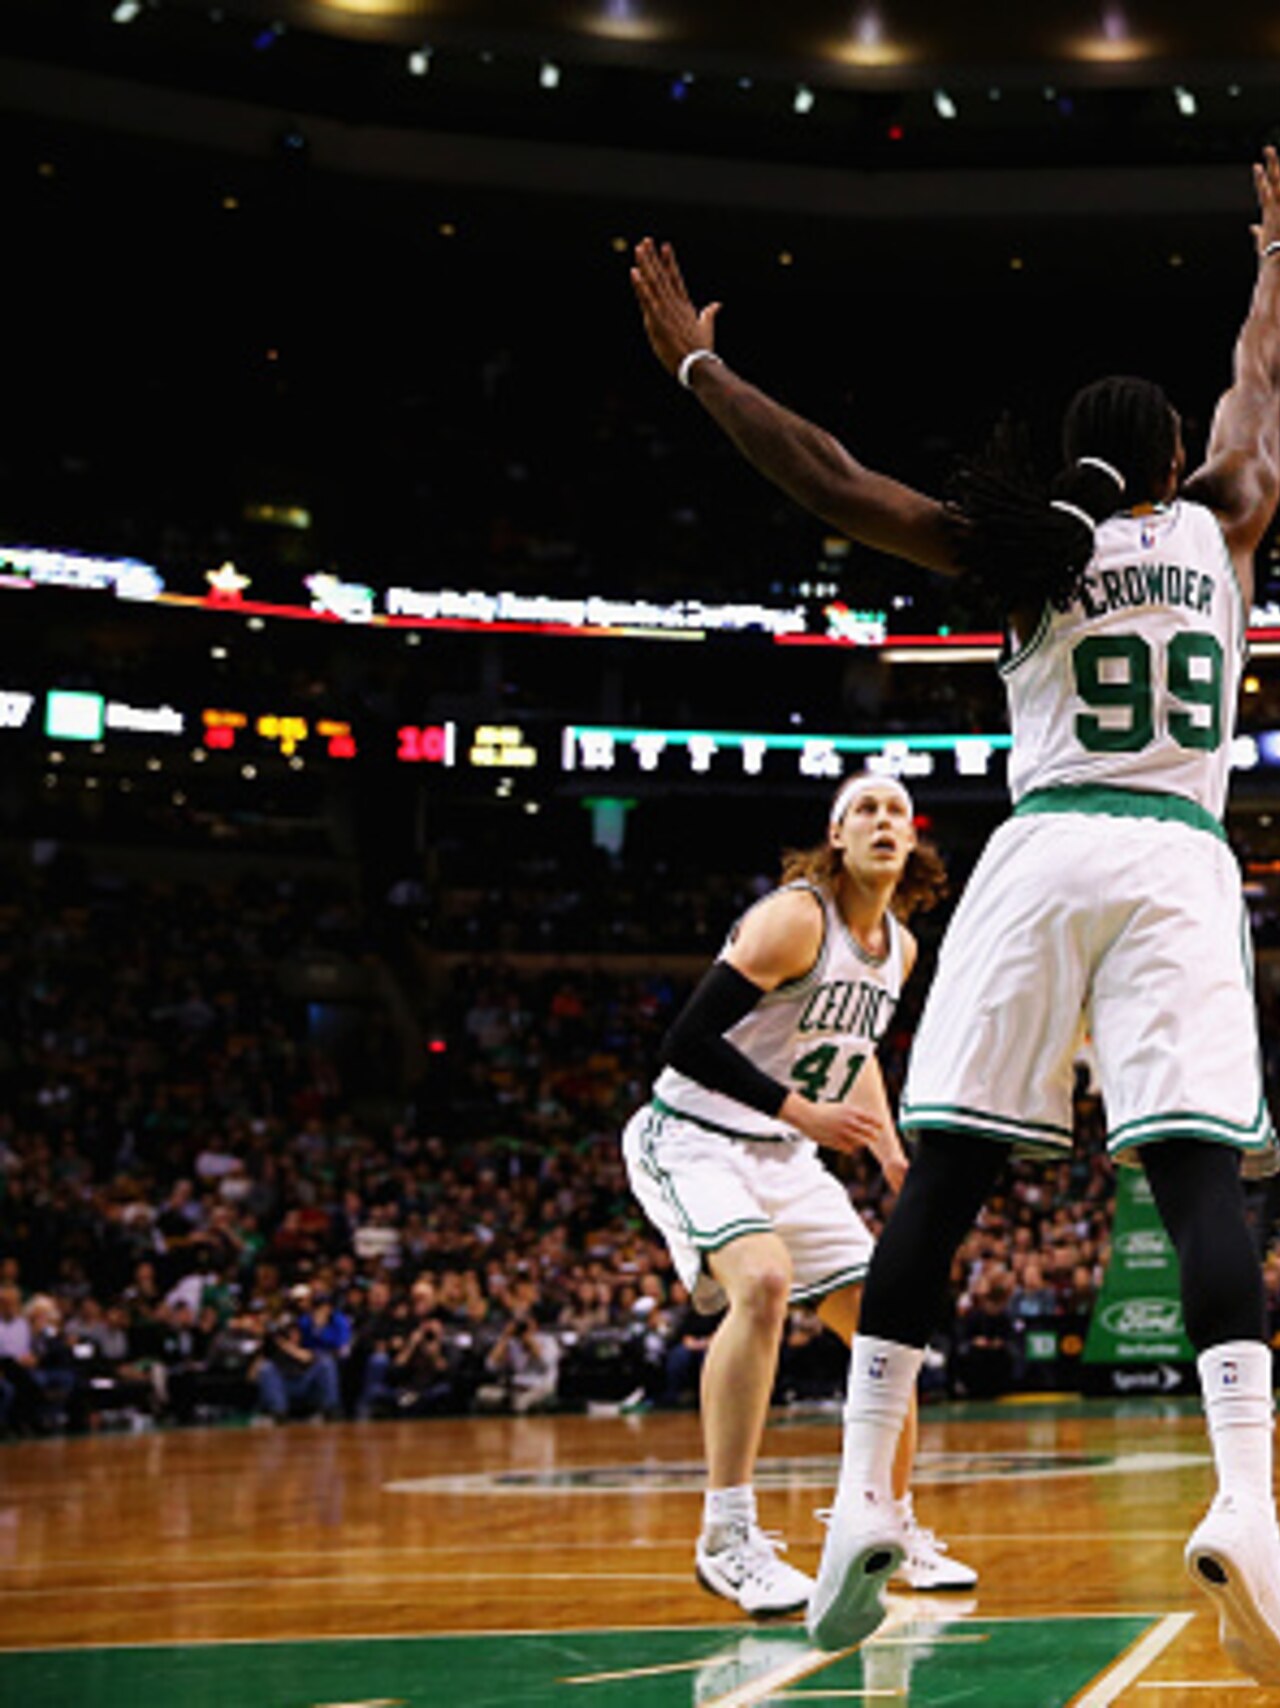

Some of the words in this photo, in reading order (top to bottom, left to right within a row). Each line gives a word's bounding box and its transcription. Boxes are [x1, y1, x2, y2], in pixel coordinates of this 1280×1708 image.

[1083, 563, 1214, 618] CROWDER
[1073, 631, 1223, 752] 99
[396, 724, 446, 762] 10
[799, 980, 901, 1042] CELTIC
[790, 1042, 866, 1103] 41
[1117, 1303, 1177, 1333] Ford
